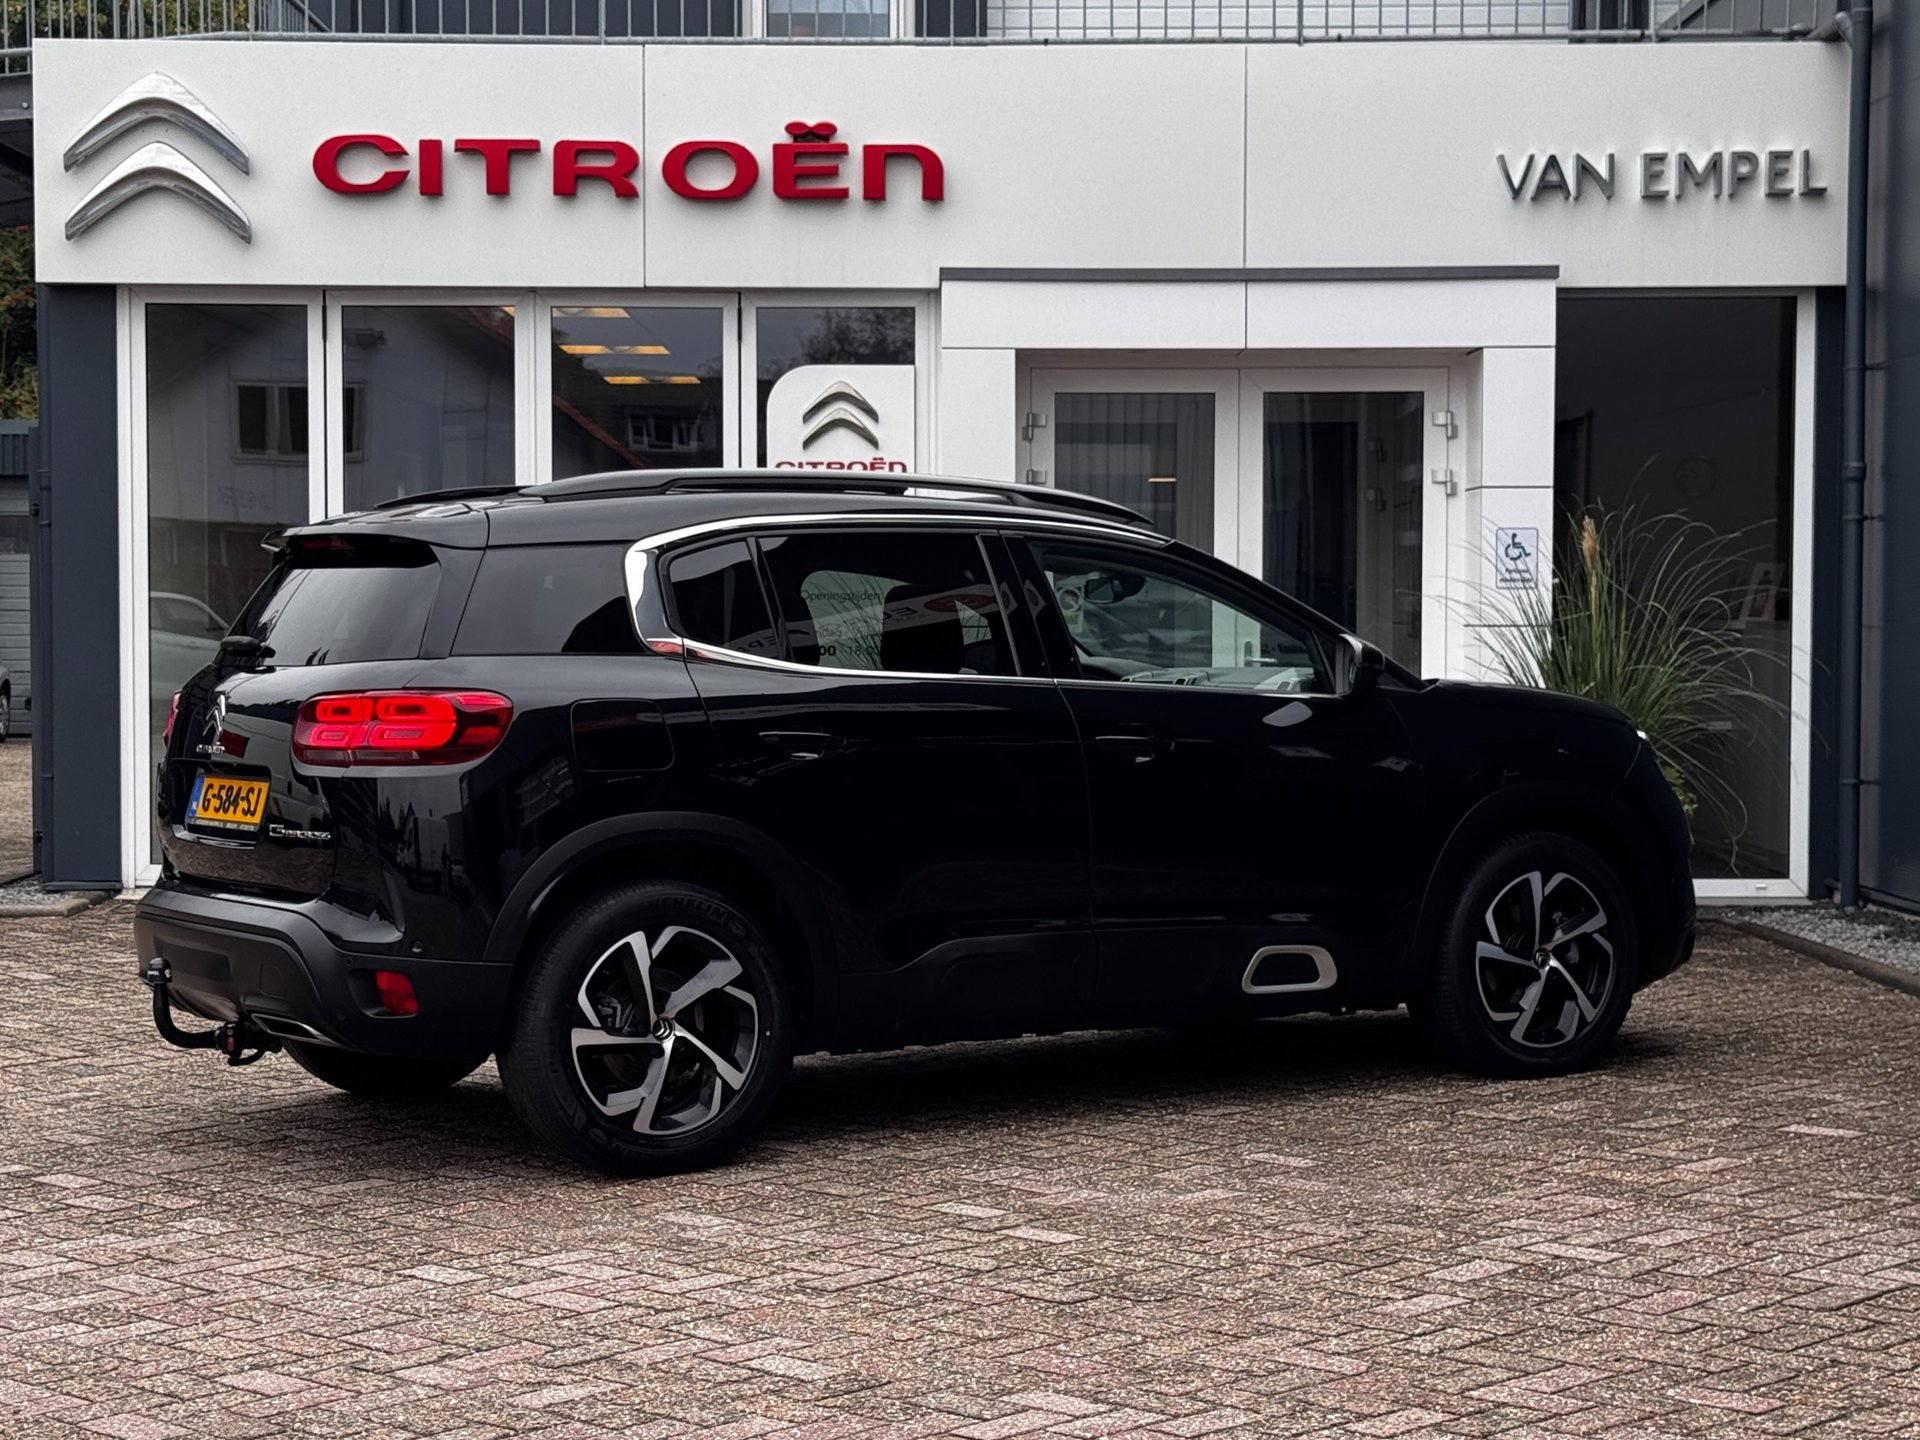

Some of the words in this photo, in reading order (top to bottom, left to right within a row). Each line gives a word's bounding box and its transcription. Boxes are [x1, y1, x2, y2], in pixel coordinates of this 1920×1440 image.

[312, 121, 945, 201] CITROËN
[1496, 152, 1616, 200] VAN
[1639, 149, 1828, 199] EMPEL
[202, 783, 262, 817] G-584-SJ
